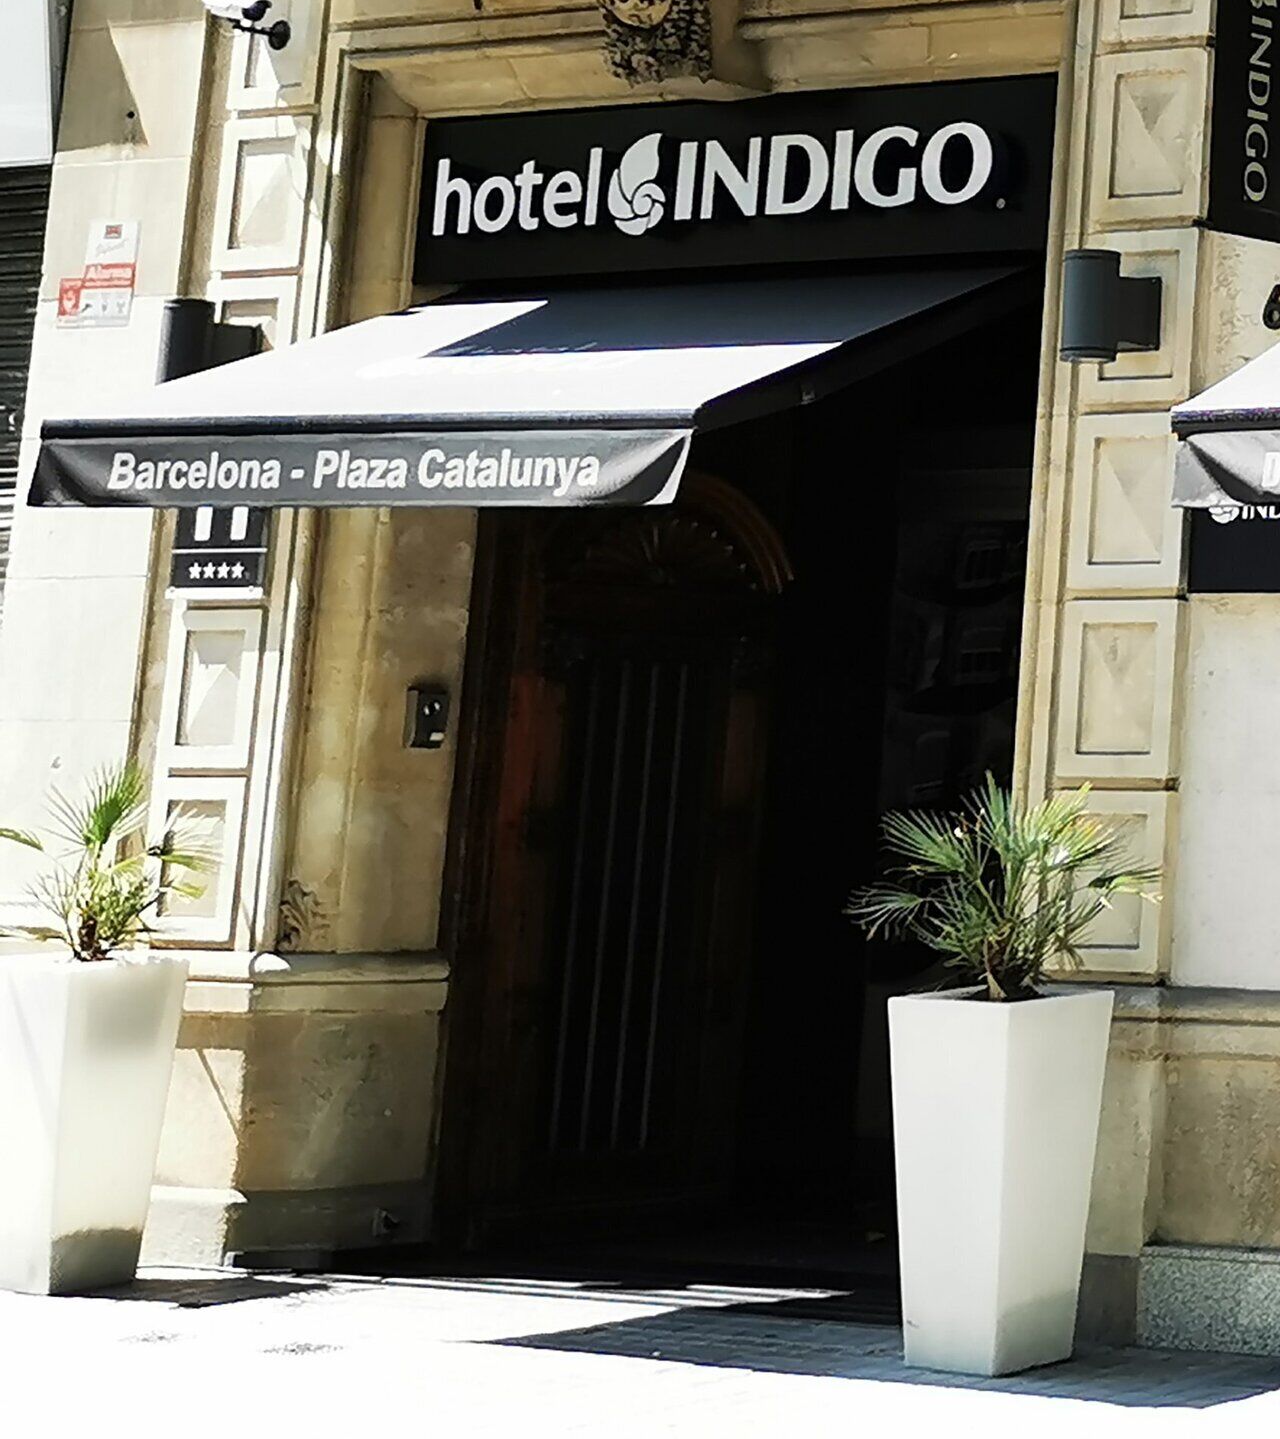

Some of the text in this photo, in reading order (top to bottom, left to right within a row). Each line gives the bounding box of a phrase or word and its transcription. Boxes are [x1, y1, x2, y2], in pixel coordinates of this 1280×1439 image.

[1244, 15, 1274, 202] INDIGO
[432, 121, 994, 237] hotel INDIGO
[108, 451, 281, 490] Barcelona
[313, 450, 407, 489] Plaza
[417, 447, 601, 497] Catalunya
